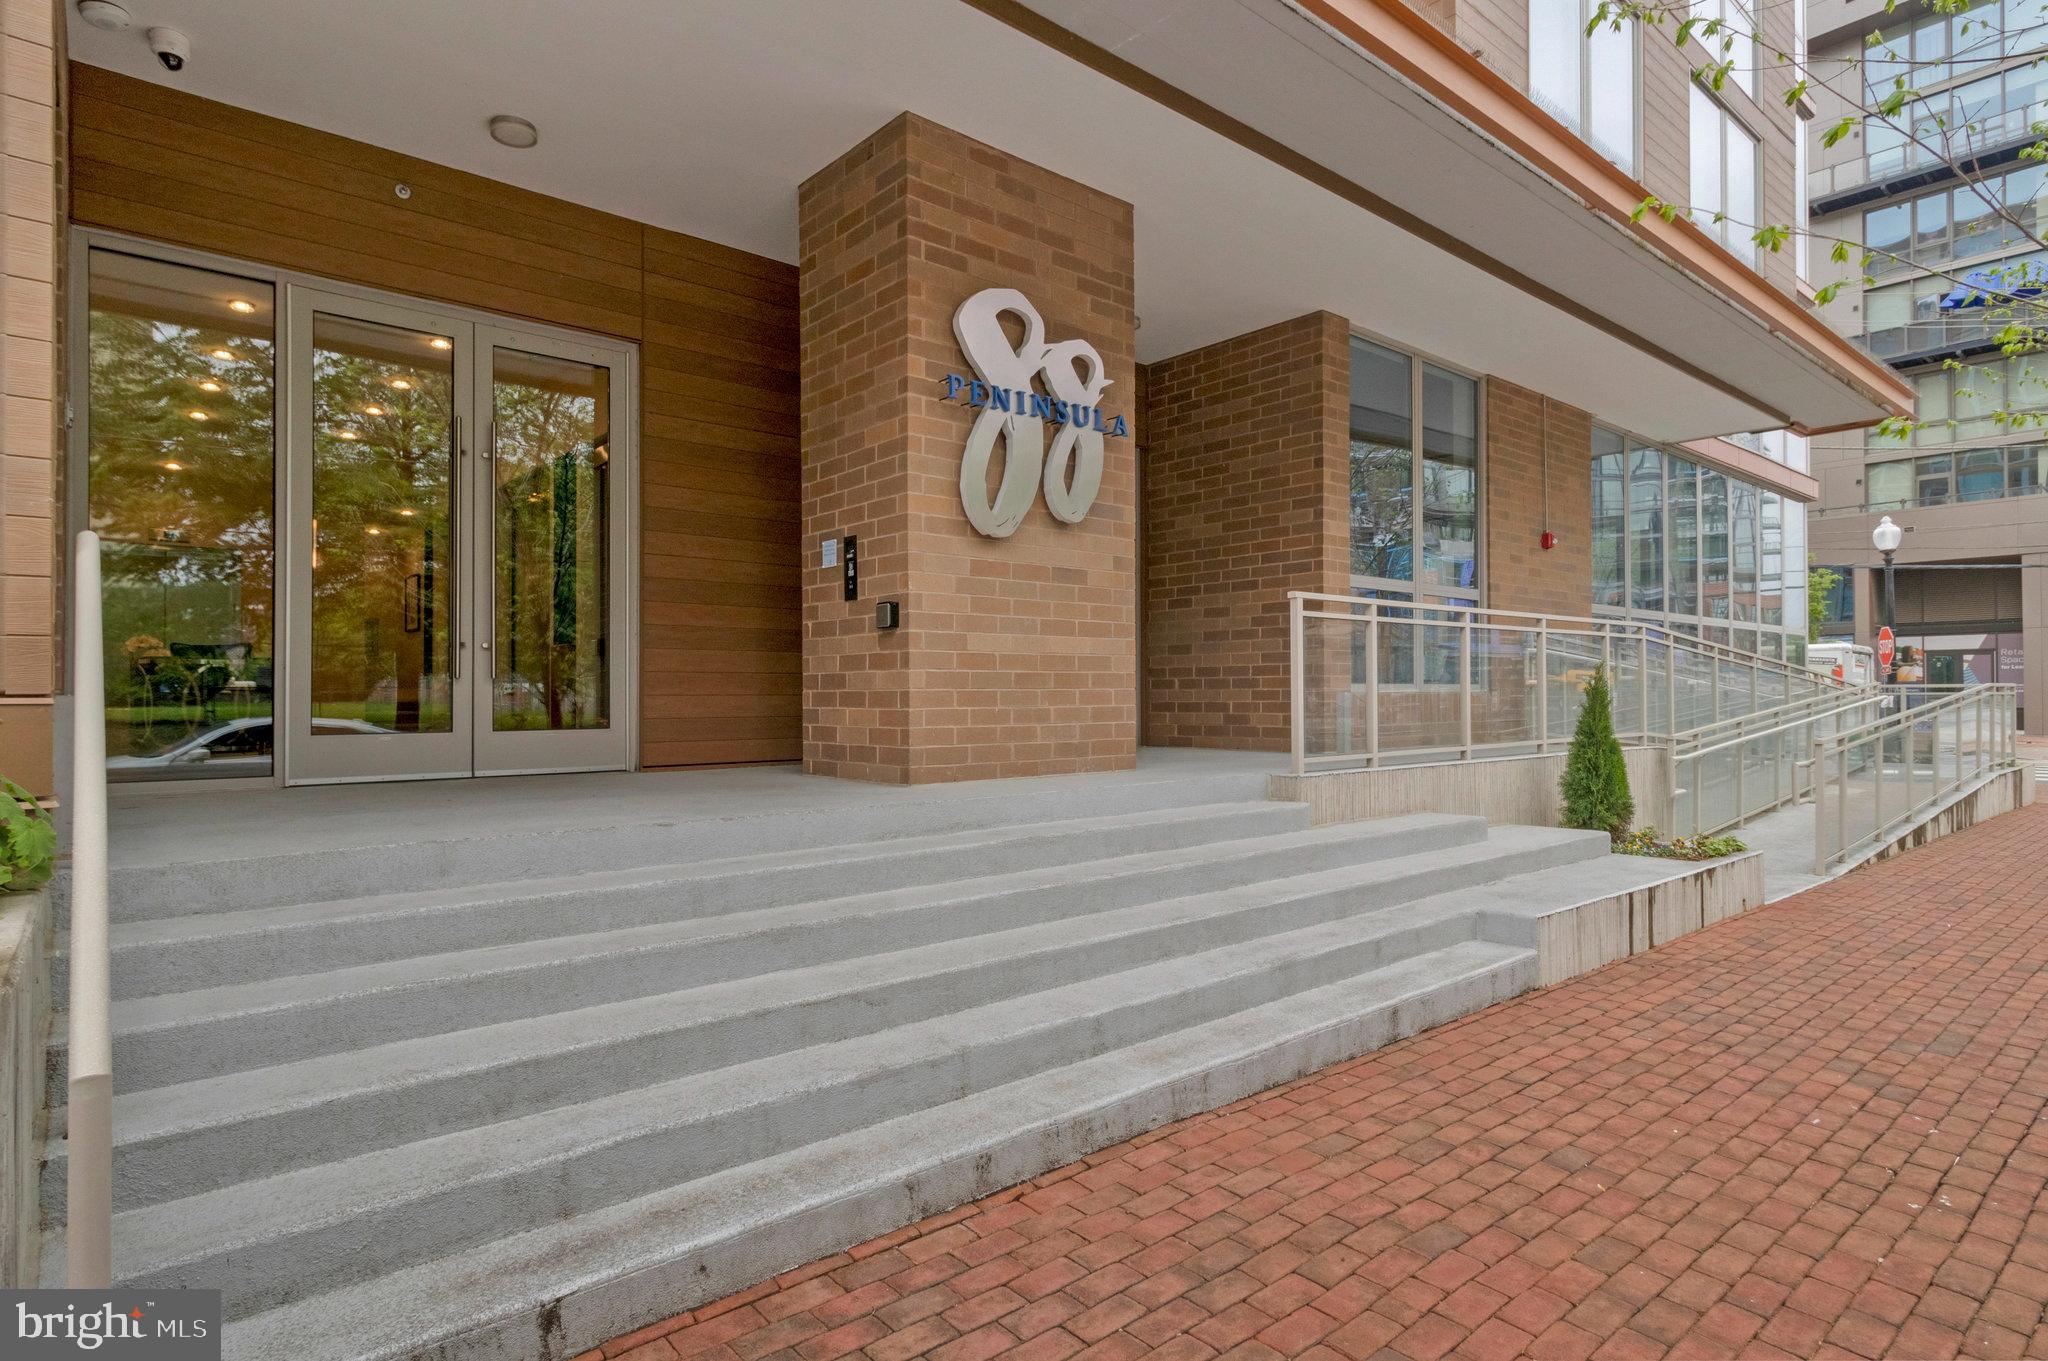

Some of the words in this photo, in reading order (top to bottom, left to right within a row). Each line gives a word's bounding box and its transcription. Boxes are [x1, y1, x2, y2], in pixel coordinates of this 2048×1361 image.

[945, 373, 1129, 438] PENINSULA
[1879, 639, 1894, 655] STOP
[2001, 648, 2024, 656] Reta
[2001, 656, 2024, 664] Spac
